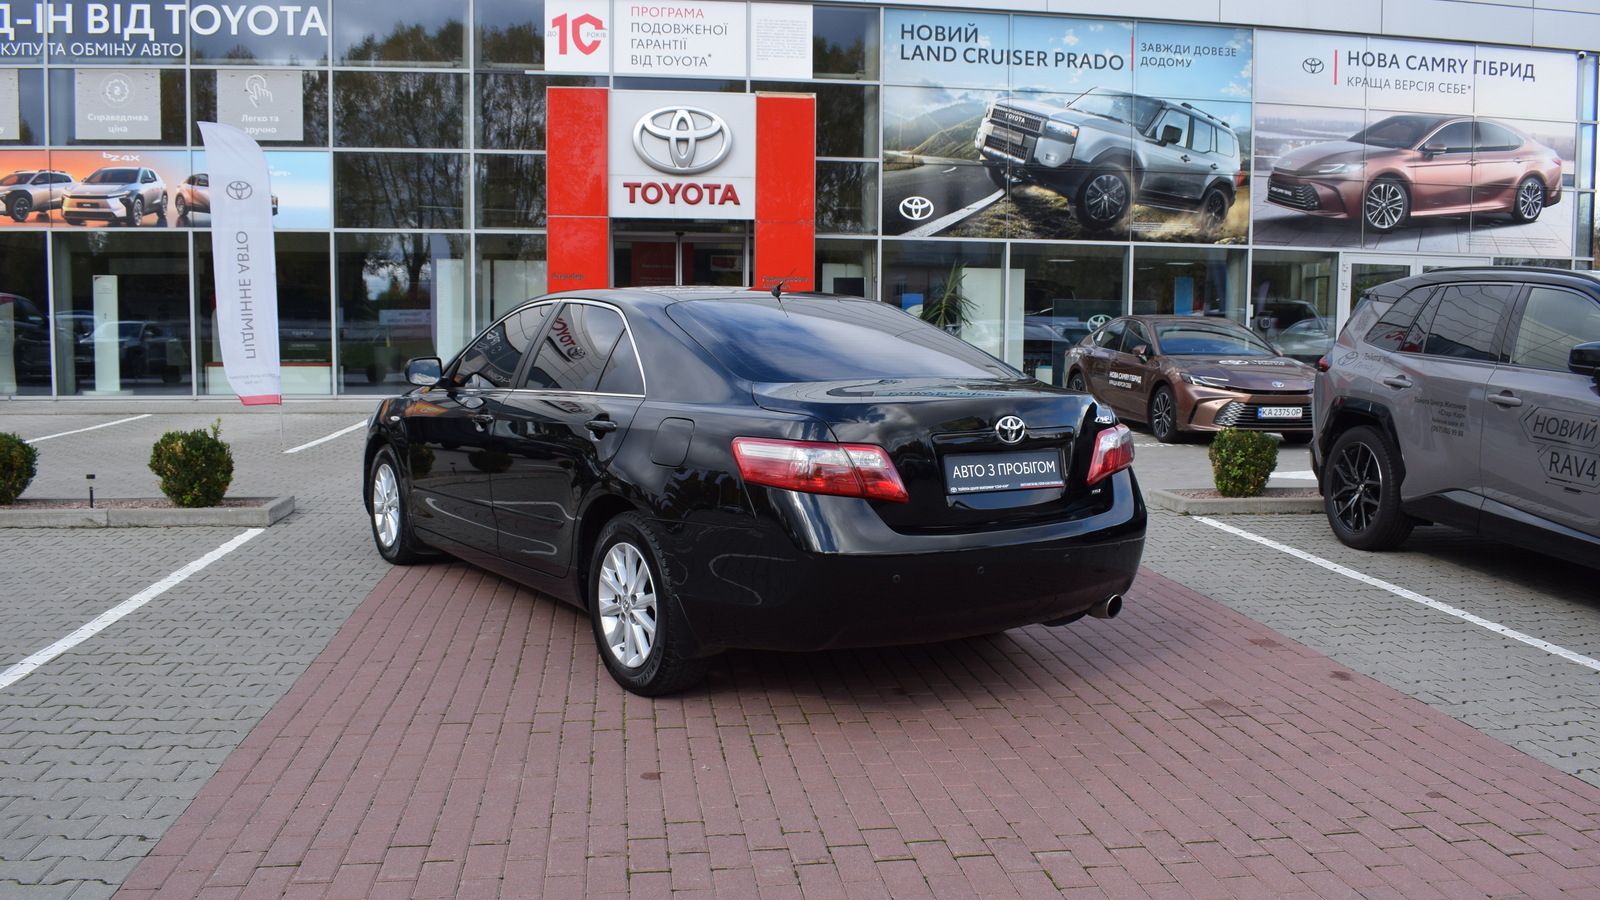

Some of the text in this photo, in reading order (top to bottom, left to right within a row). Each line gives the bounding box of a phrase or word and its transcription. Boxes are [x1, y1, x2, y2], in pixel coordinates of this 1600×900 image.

[631, 6, 704, 19] ПРОГРАМА
[87, 3, 155, 41] ВІД
[164, 4, 328, 37] TOYOTA
[631, 22, 729, 36] ПОДОВЖЕНОЇ
[901, 23, 978, 43] НОВИЙ
[48, 43, 66, 56] ТА
[70, 43, 136, 57] ОБМІНУ
[140, 43, 183, 57] АВТО
[631, 37, 688, 50] ГАРАНТІЇ
[1140, 42, 1237, 57] ЗАВЖДИ ДОВЕЗЕ
[631, 54, 653, 67] ВІД
[900, 44, 1124, 71] LAND CRUISER PRADO
[1140, 56, 1192, 68] ДОДОМУ
[1347, 50, 1536, 82] НОВА CAMRY ГІБРИД
[1347, 76, 1391, 91] КРАЩА
[1395, 79, 1435, 92] ВЕРСІЯ
[87, 113, 149, 122] Справедлива
[241, 114, 267, 122] Легко
[1005, 112, 1026, 124] TOYOTA
[108, 125, 128, 133] ціна
[245, 126, 277, 135] зручно
[623, 182, 740, 206] TOYOTA
[1533, 414, 1598, 442] НОВИЙ
[952, 464, 985, 479] АВТО
[998, 460, 1056, 476] ПРОБІГОМ
[1549, 451, 1597, 481] RAV4
